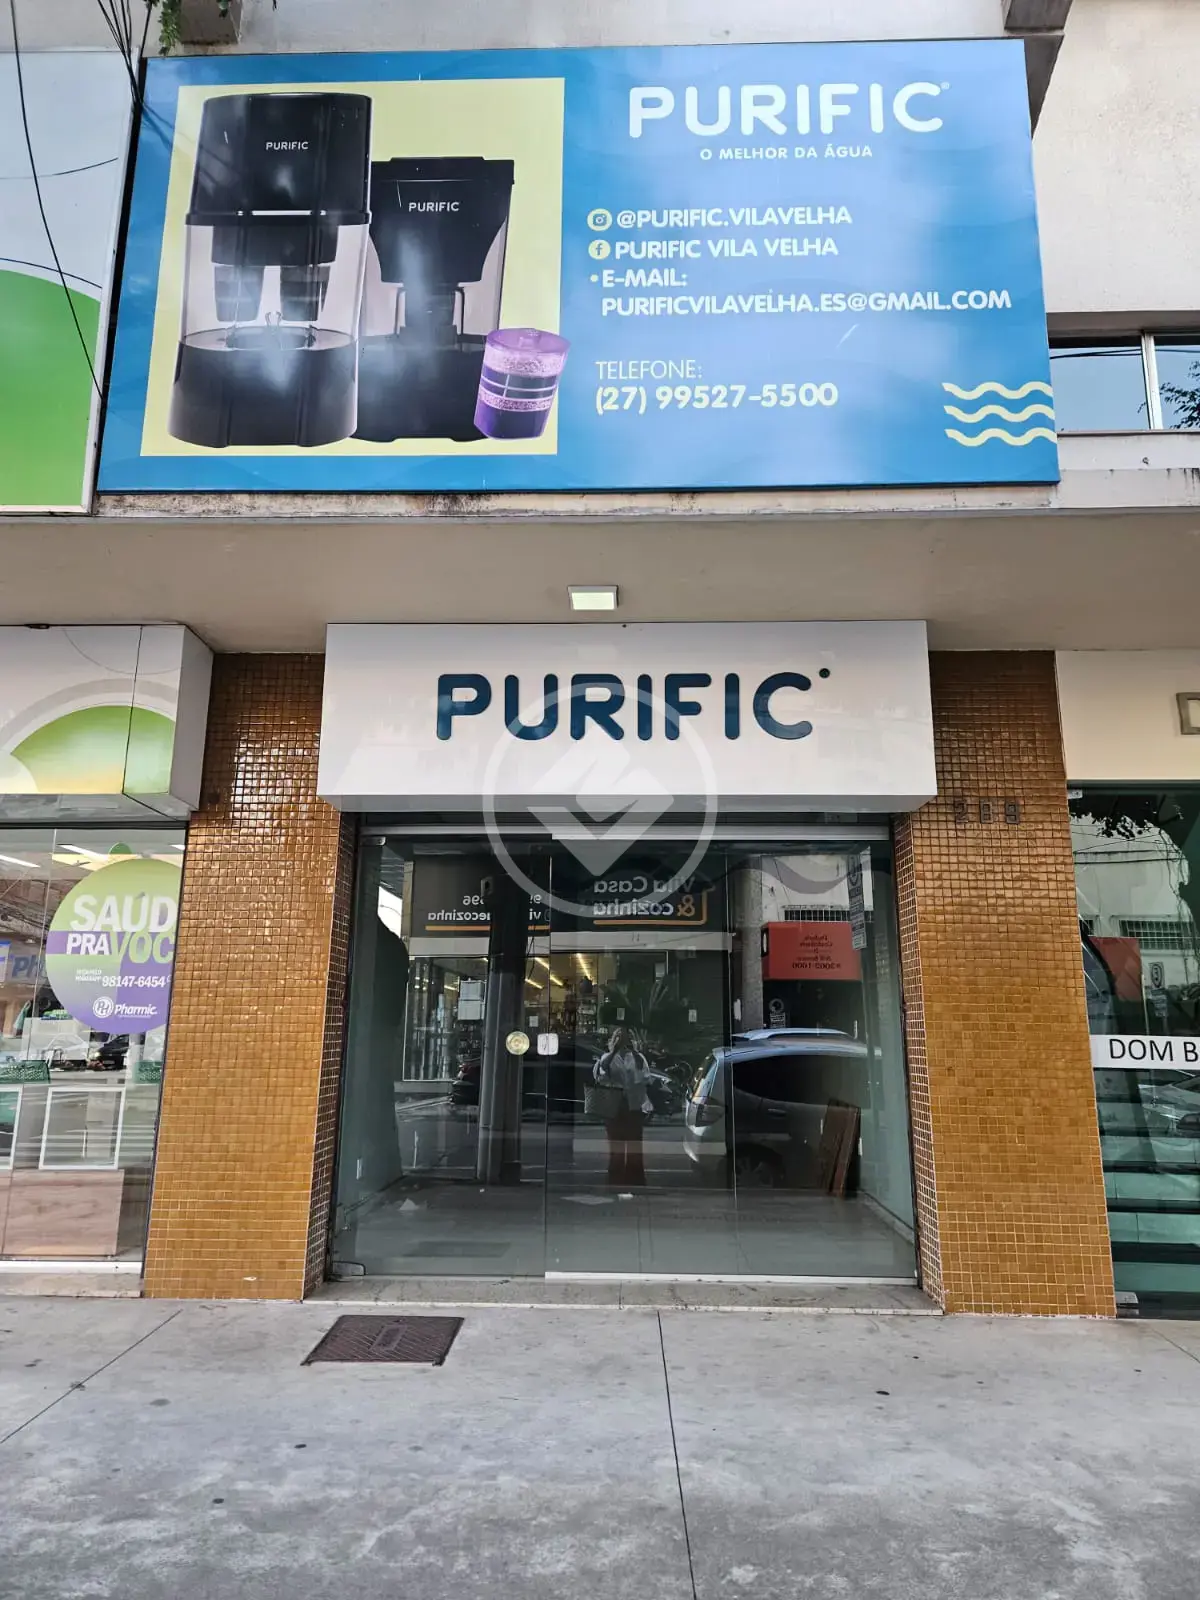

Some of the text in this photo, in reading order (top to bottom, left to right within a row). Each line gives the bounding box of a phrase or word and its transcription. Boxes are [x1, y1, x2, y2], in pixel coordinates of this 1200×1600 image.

[629, 82, 943, 138] PURIFIC
[265, 141, 309, 151] PURIFIC
[700, 143, 873, 160] O MELHOR DA ÁGUA
[408, 201, 460, 213] PURIFIC
[616, 206, 853, 229] @PURIFIC.VILAVELHA
[615, 240, 701, 260] PURIFIC
[708, 239, 757, 257] VILA
[764, 237, 838, 256] VELHA
[602, 268, 688, 288] E-MAIL:
[602, 289, 1011, 317] PURIFICVILAVELHA.ES@GMAIL.COM
[595, 359, 703, 380] TELEFONE:
[596, 382, 839, 415] (27) 99527-5500
[436, 671, 814, 741] PURIFIC
[66, 933, 110, 956] PRA
[102, 975, 166, 988] 98147-6454
[1109, 1039, 1173, 1061] DOM
